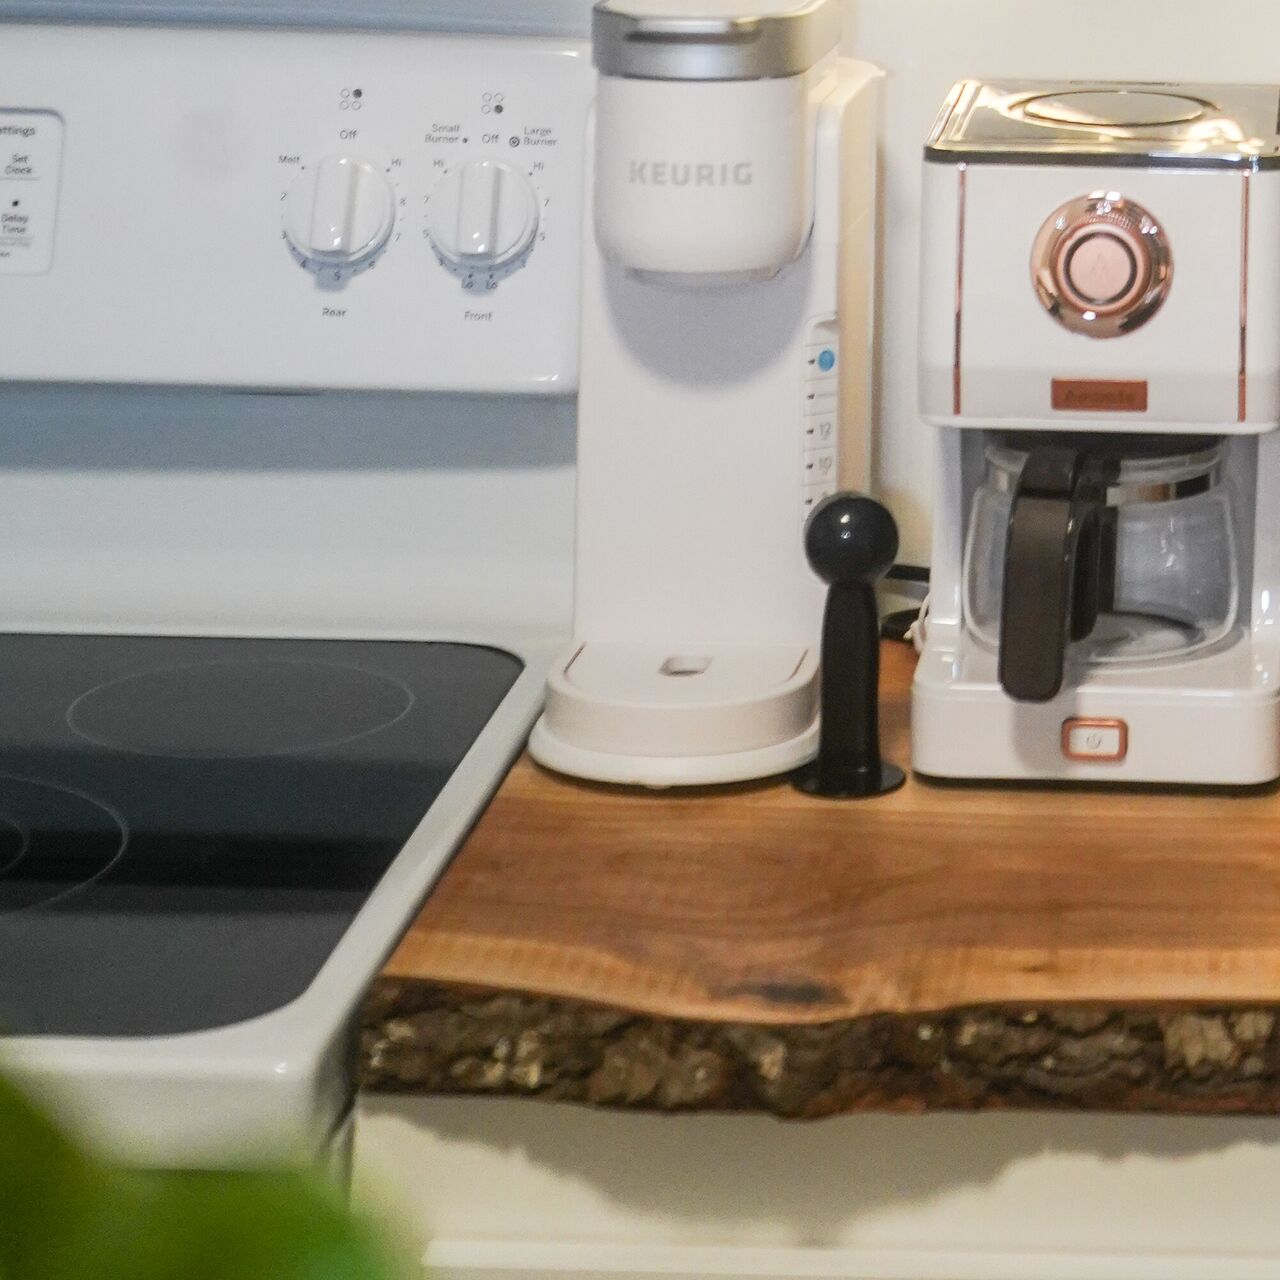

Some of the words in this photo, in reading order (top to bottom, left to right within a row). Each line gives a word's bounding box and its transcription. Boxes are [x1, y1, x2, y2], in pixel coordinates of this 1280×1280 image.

[431, 123, 460, 133] Small
[524, 126, 552, 137] Large
[340, 129, 358, 140] Off
[424, 134, 460, 144] Burner
[481, 134, 499, 144] Off
[523, 137, 557, 146] Burner
[628, 160, 753, 186] KEURIG
[464, 311, 493, 321] Front
